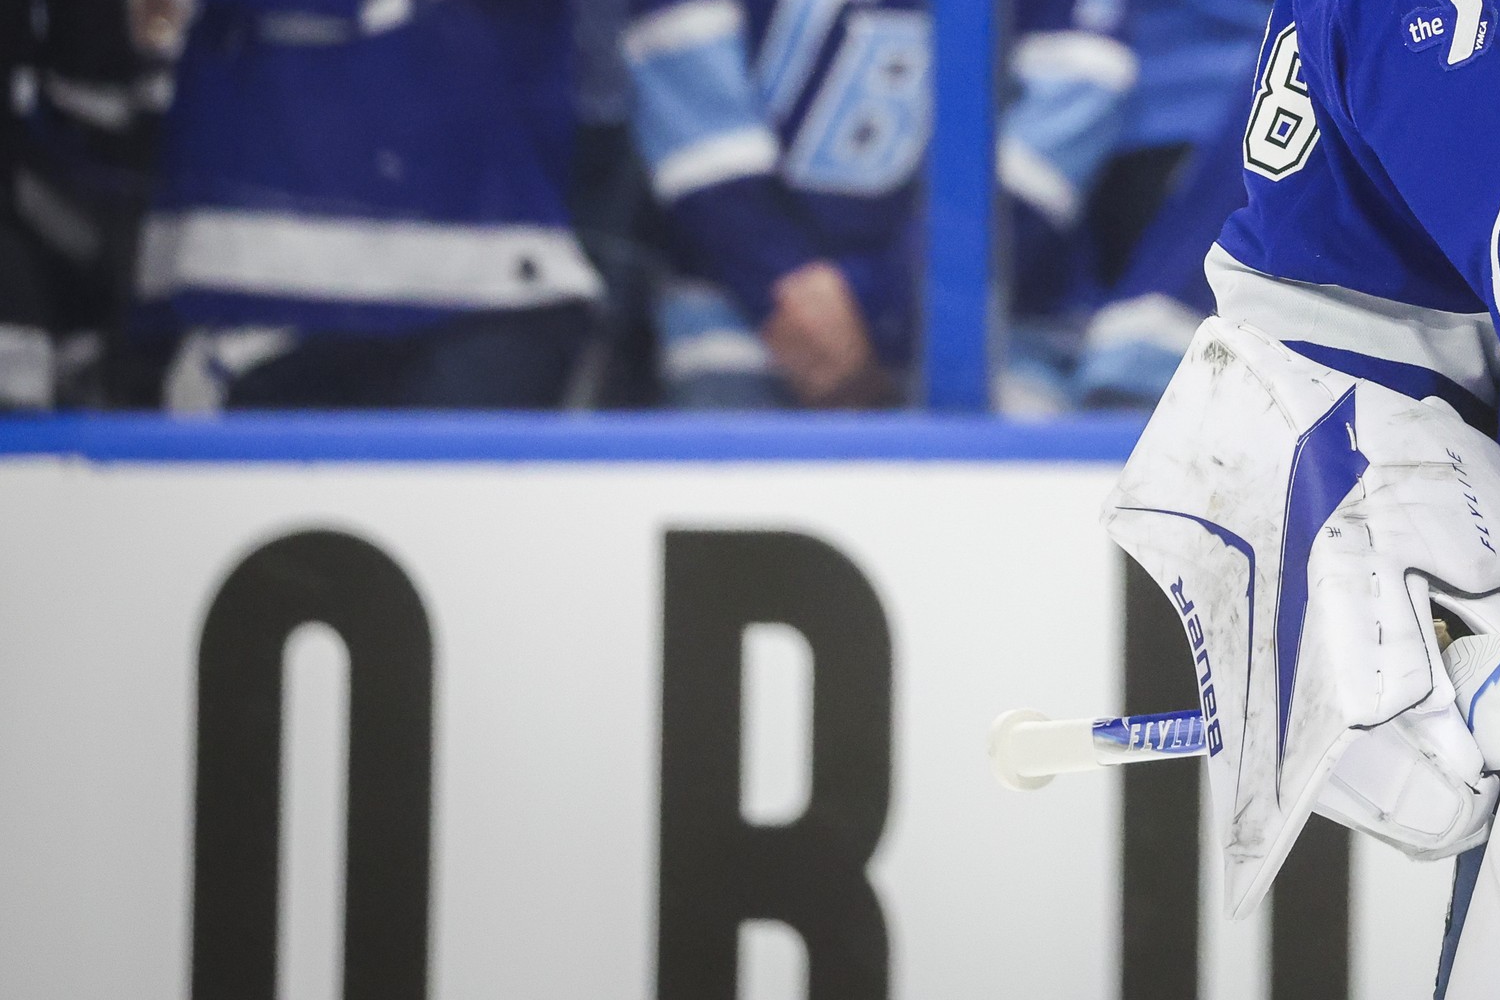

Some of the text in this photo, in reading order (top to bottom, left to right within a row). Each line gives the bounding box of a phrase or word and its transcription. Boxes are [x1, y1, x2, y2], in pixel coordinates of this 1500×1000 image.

[1408, 17, 1444, 43] the
[1474, 21, 1488, 51] YMCA
[1243, 12, 1321, 182] 8
[1446, 448, 1497, 556] FLYLITE
